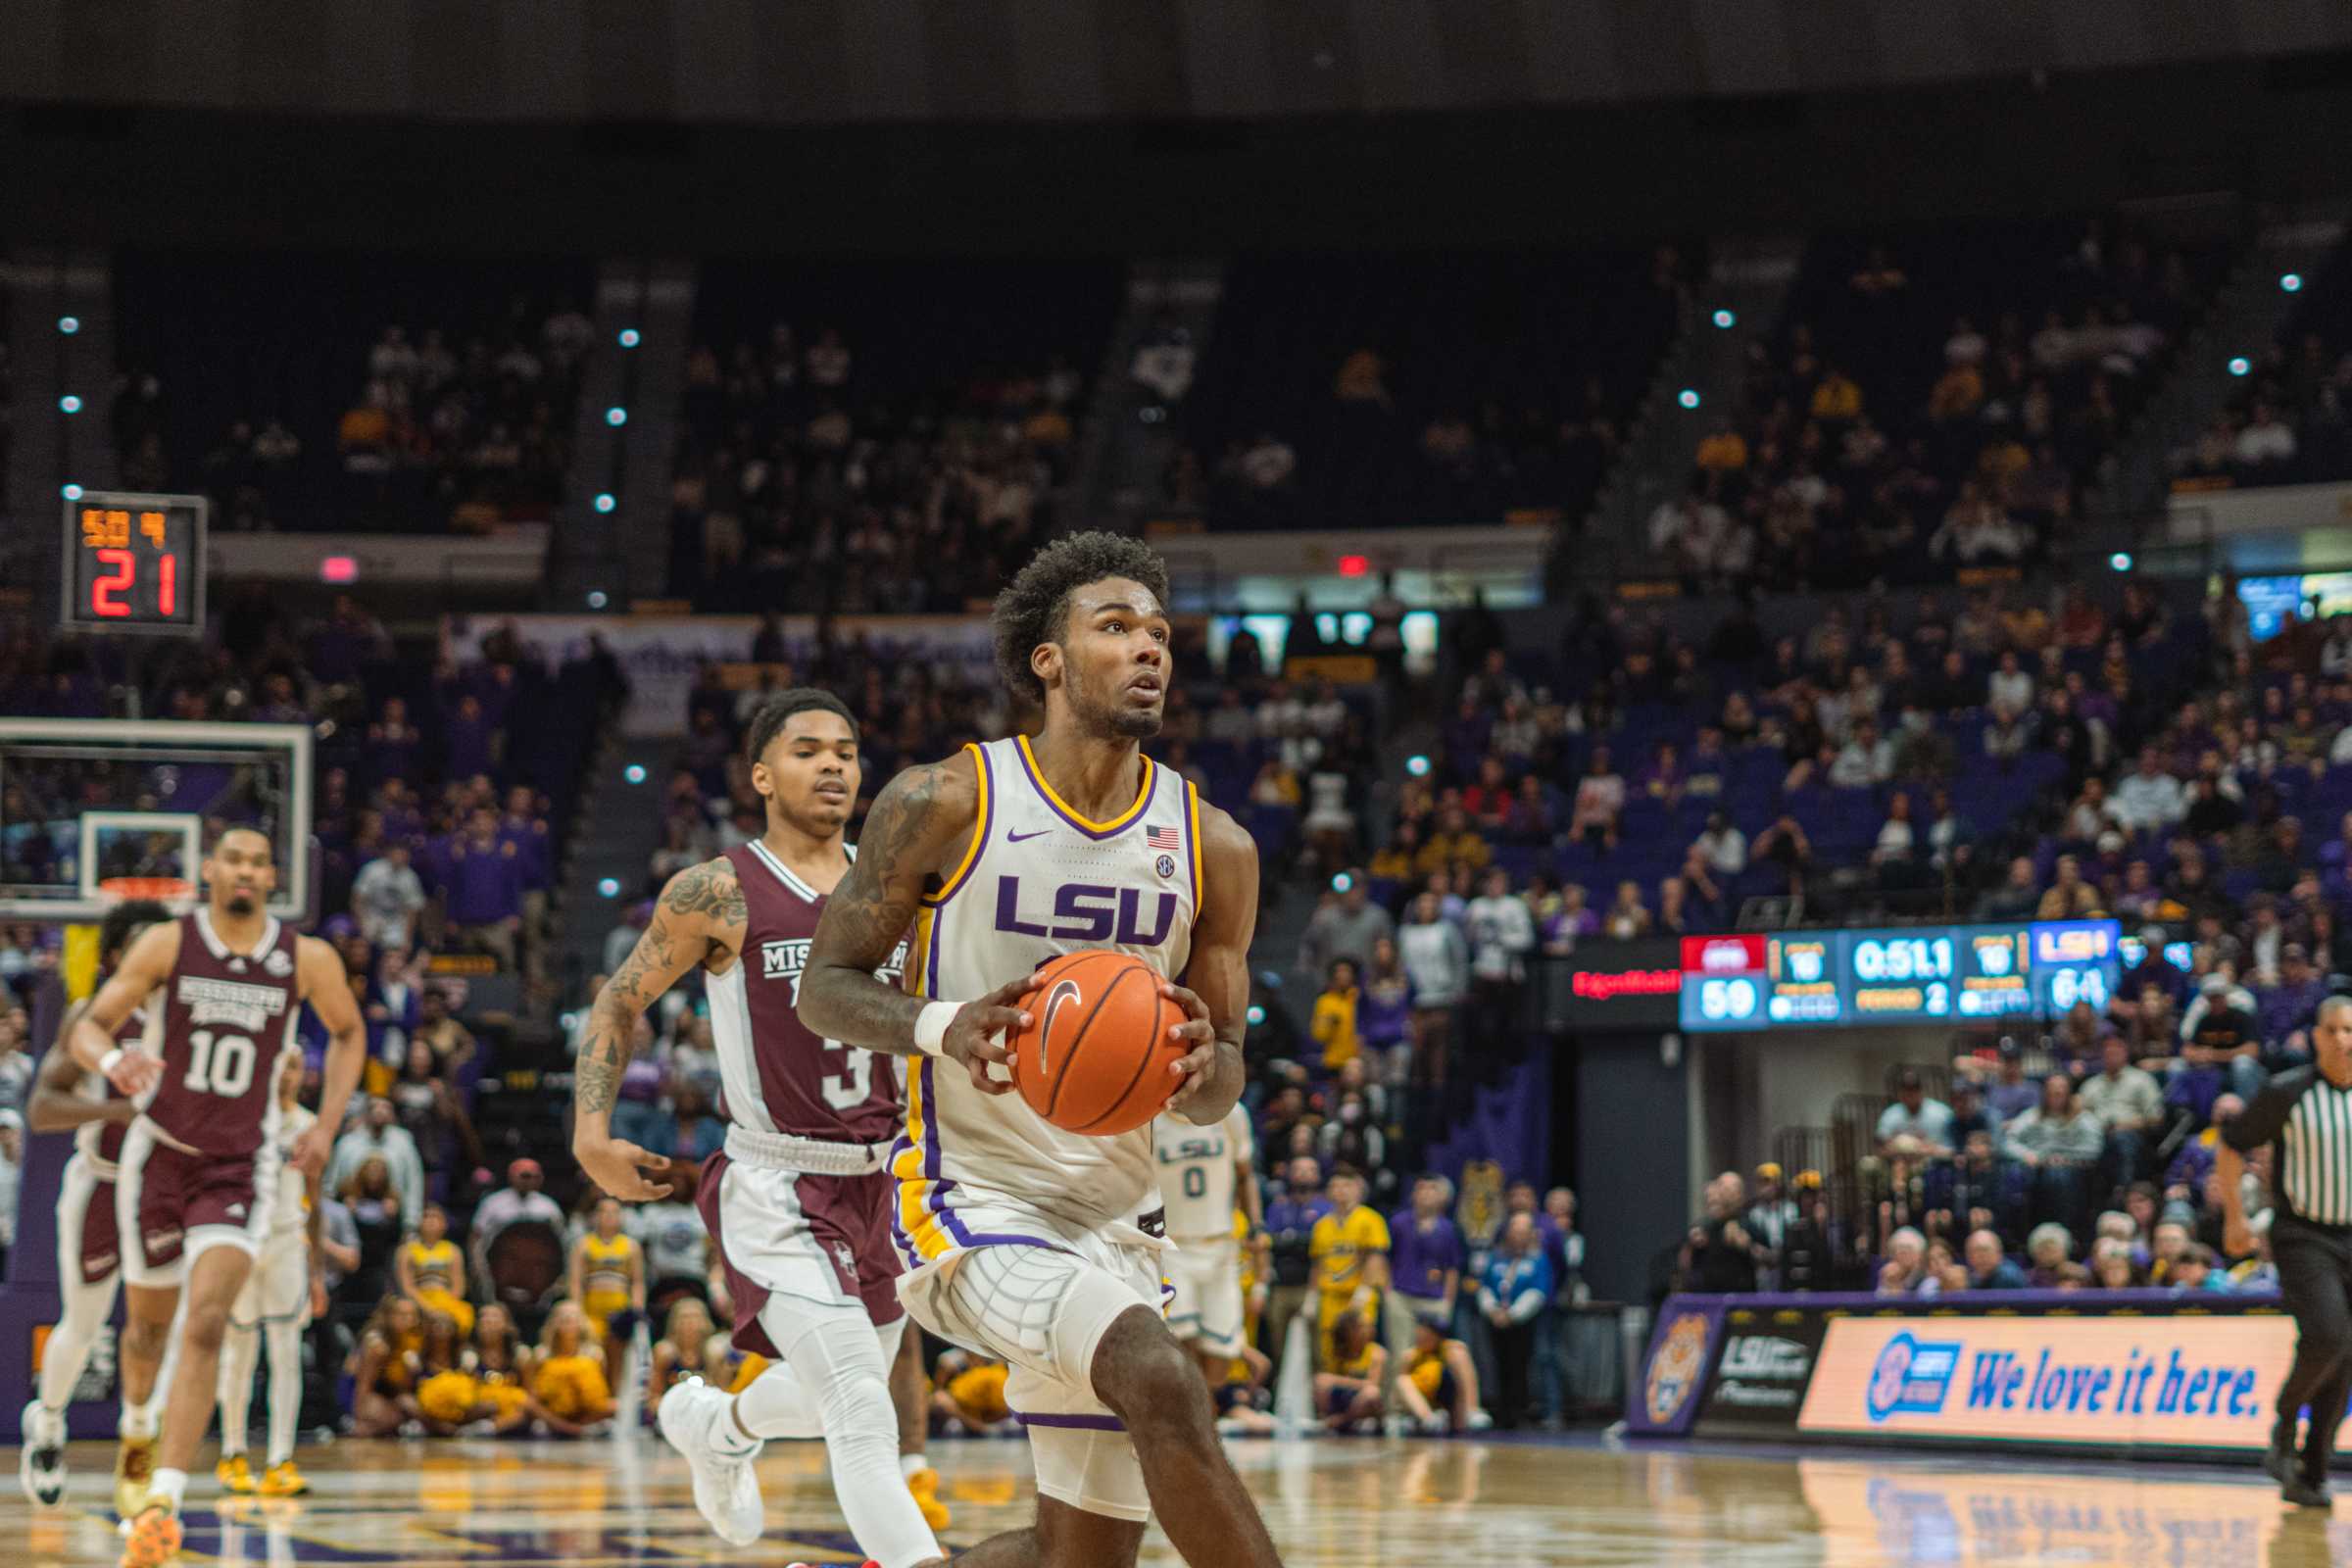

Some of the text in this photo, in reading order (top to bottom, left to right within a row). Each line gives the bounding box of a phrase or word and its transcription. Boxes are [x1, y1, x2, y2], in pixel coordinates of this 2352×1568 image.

[92, 548, 175, 616] 21
[995, 874, 1178, 947] LSU
[1701, 979, 1755, 1020] 59
[183, 1031, 257, 1098] 10
[821, 1036, 874, 1110] 3
[1159, 1139, 1224, 1165] LSU
[1183, 1166, 1207, 1199] 0
[1968, 1348, 2258, 1415] We love it here.
